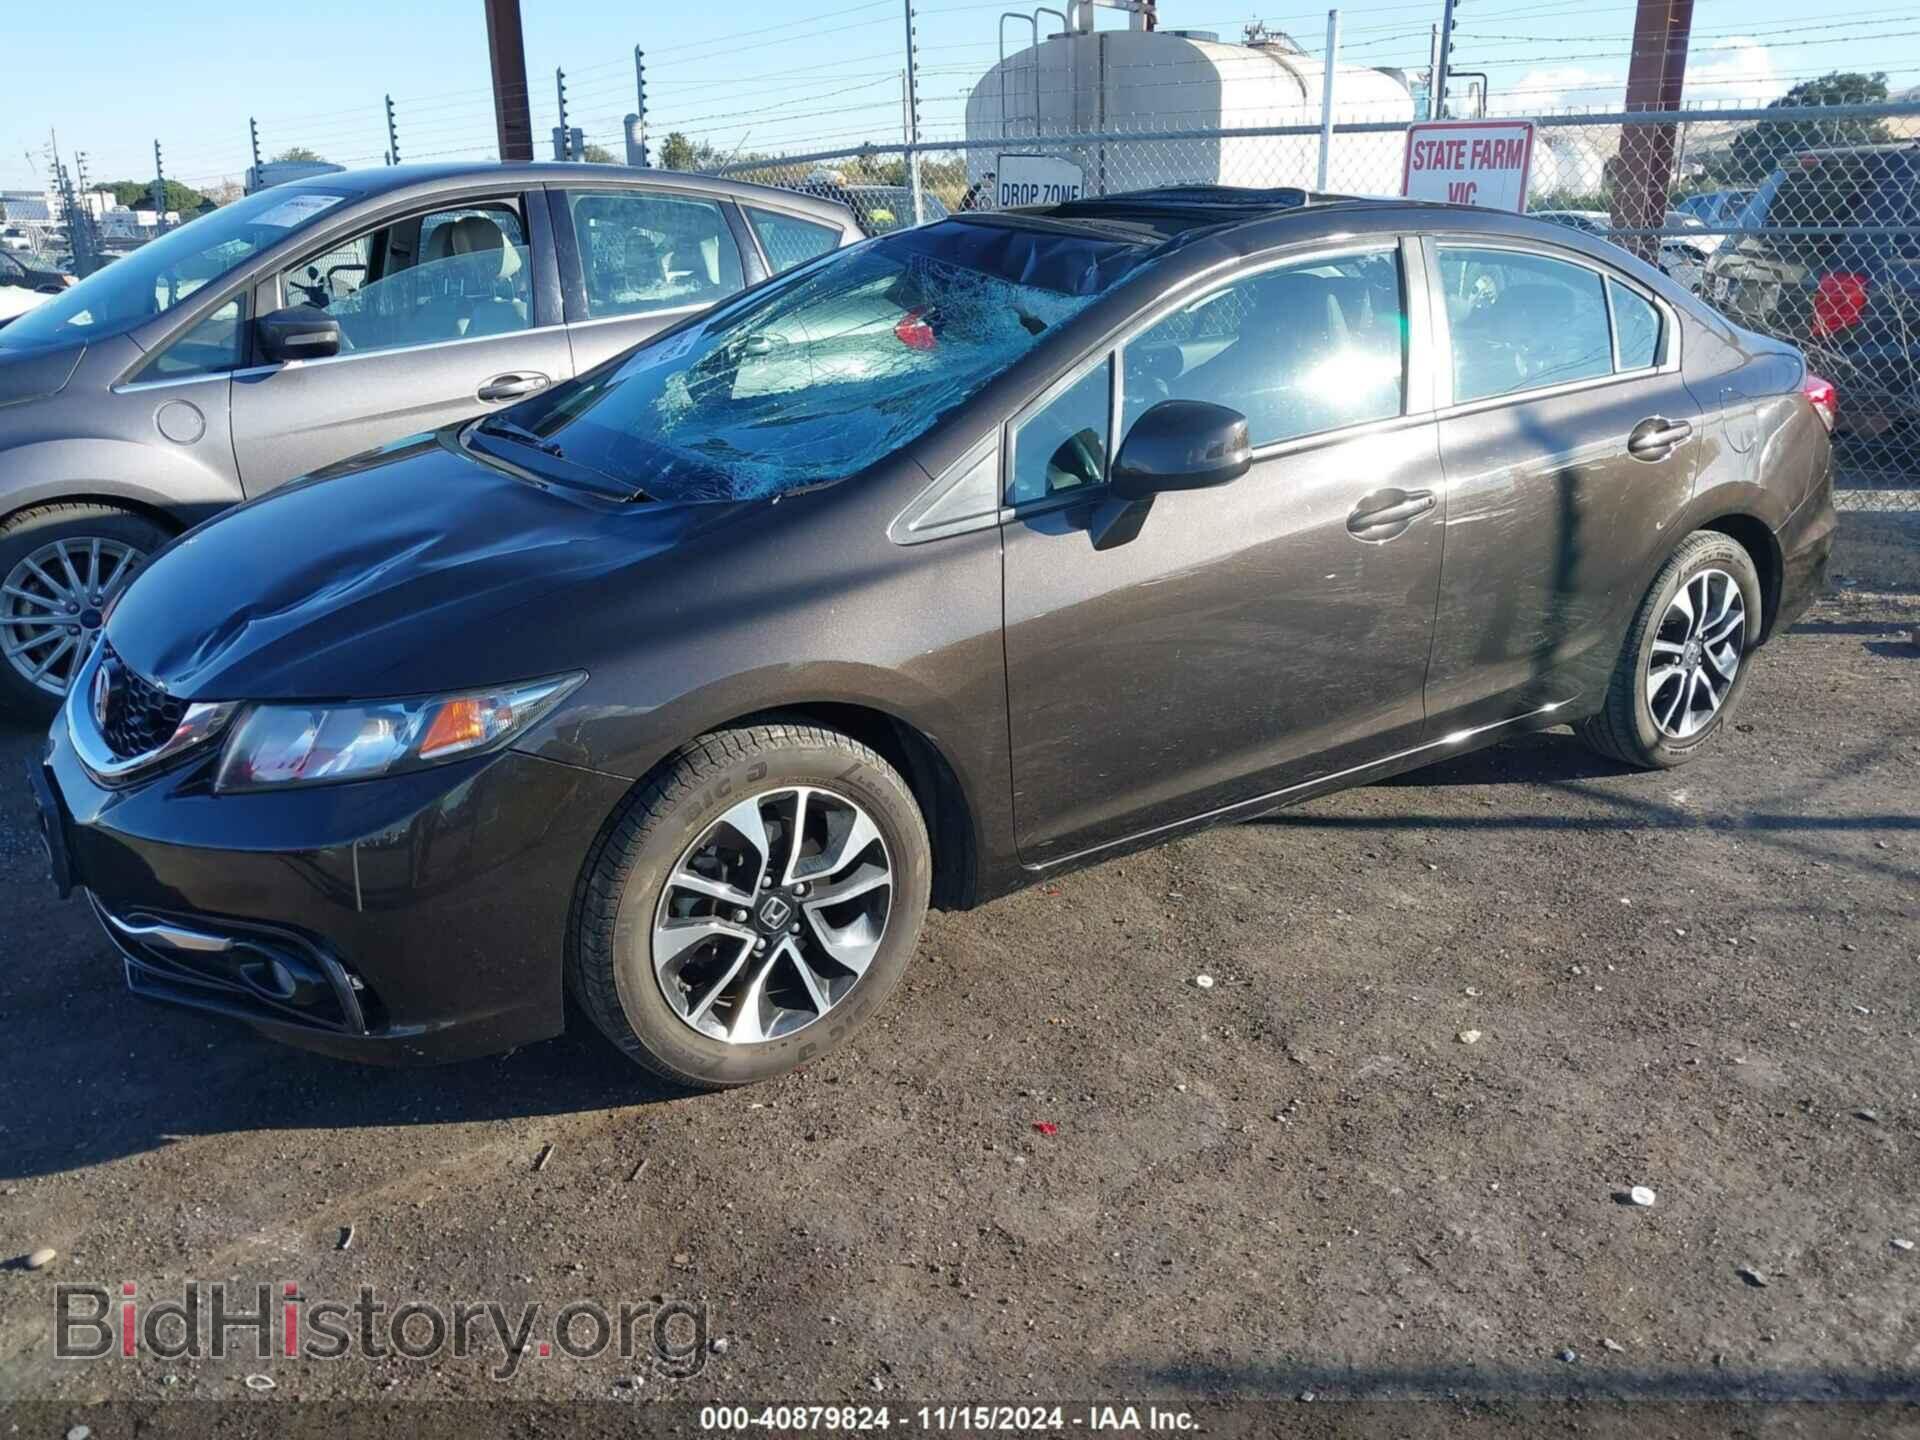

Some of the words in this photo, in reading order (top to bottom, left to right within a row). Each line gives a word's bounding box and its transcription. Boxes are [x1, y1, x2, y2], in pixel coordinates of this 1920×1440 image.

[1413, 140, 1467, 170] STATE
[1470, 139, 1524, 170] FARM
[1002, 183, 1039, 206] DROP
[1043, 184, 1079, 203] ZONE
[1449, 182, 1477, 205] VIC
